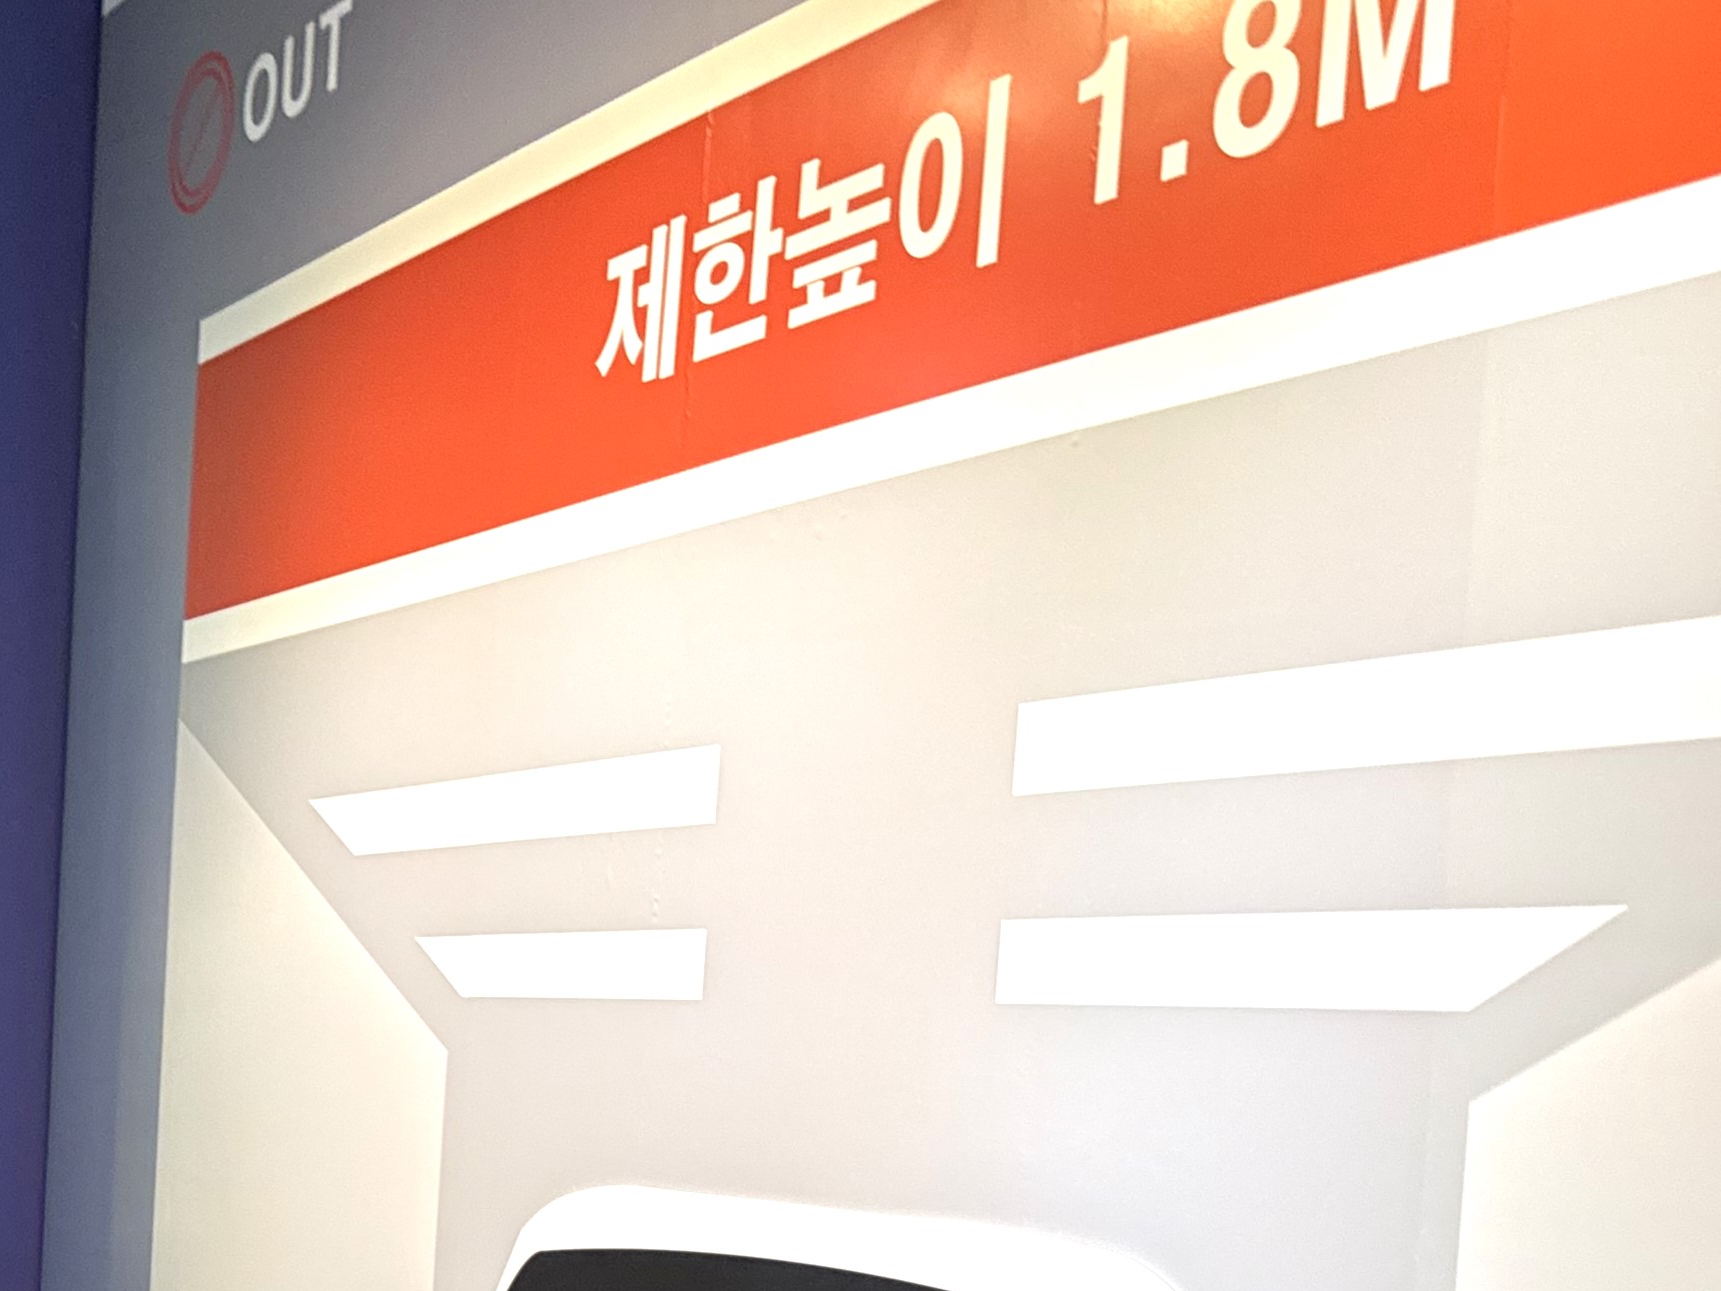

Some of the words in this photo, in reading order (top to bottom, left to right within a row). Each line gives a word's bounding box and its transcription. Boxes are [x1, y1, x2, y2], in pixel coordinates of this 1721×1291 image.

[243, 0, 354, 142] OUT
[595, 73, 1012, 384] 제한높이
[1078, 0, 1456, 205] 1.8M
